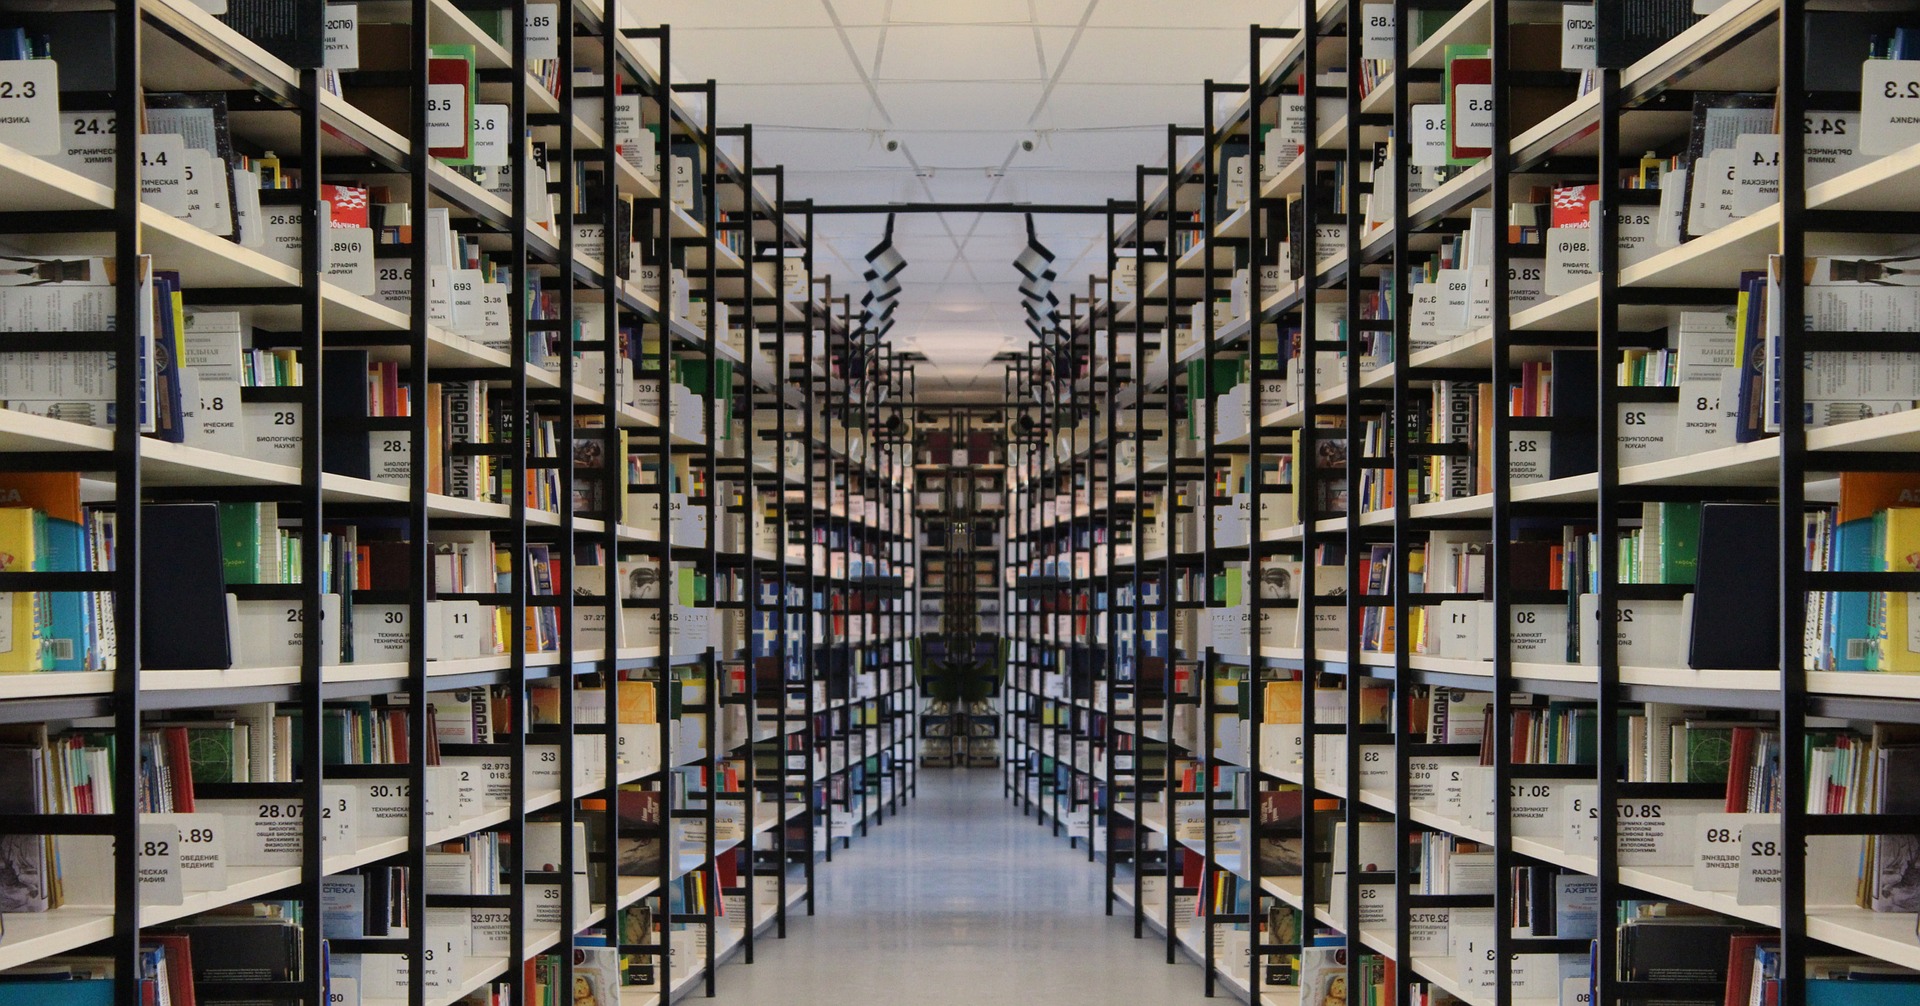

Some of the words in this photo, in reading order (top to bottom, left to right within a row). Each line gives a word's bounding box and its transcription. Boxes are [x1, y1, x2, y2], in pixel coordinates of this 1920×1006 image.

[454, 283, 472, 291] 693
[274, 411, 295, 425] 28
[385, 612, 403, 623] 30
[541, 752, 556, 761] 33
[544, 890, 559, 898] 35
